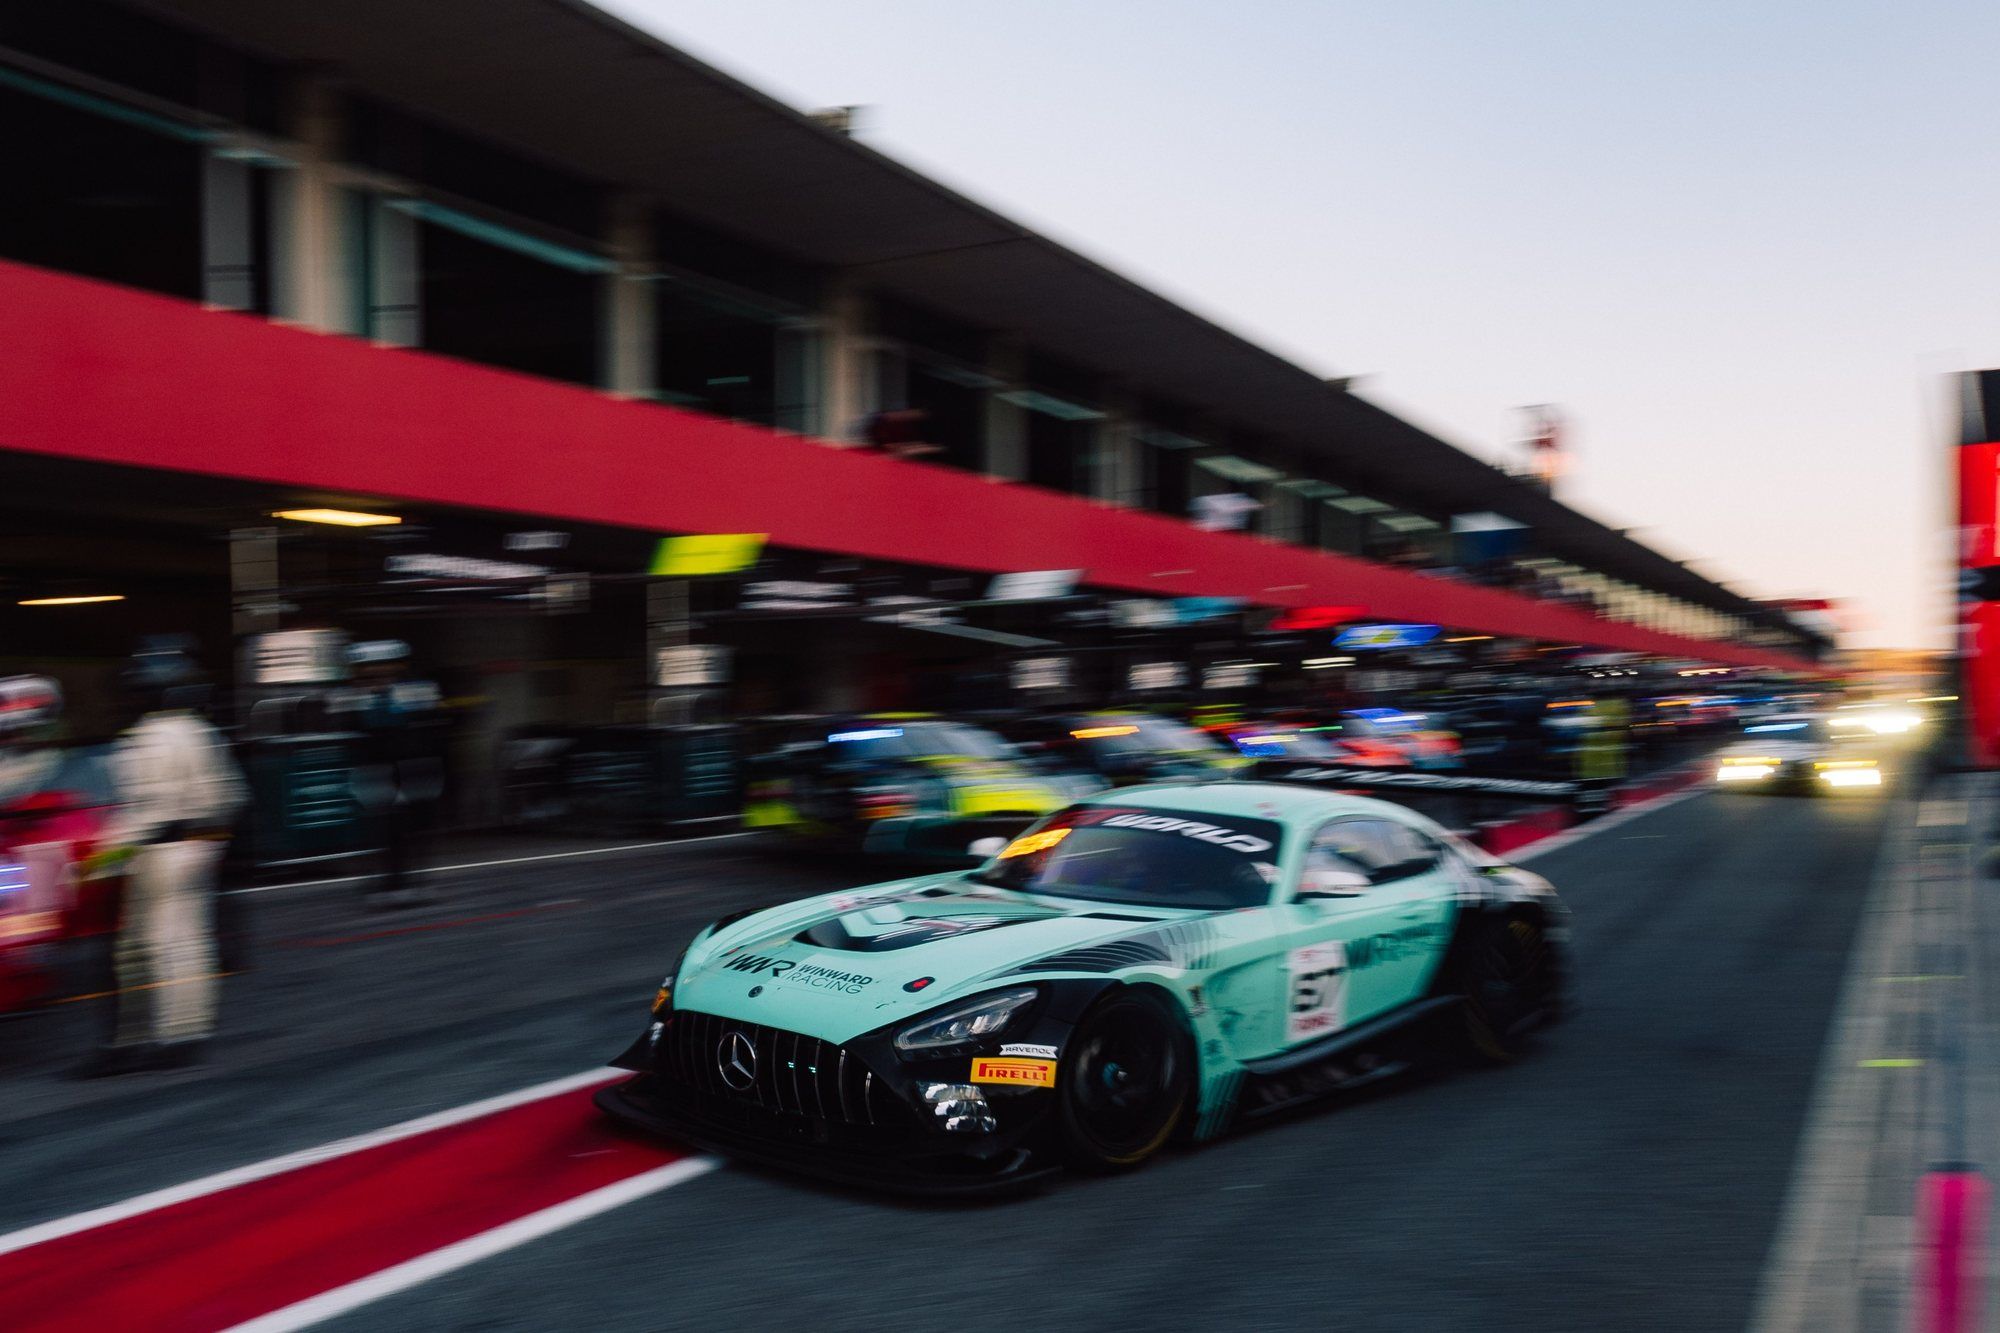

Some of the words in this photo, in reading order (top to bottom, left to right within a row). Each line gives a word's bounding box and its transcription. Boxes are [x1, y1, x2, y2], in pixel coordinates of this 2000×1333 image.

[786, 972, 864, 995] RACING
[798, 964, 873, 986] WINWARD
[1005, 1045, 1052, 1056] RAVENOL
[978, 1062, 1049, 1082] PIRELLI
